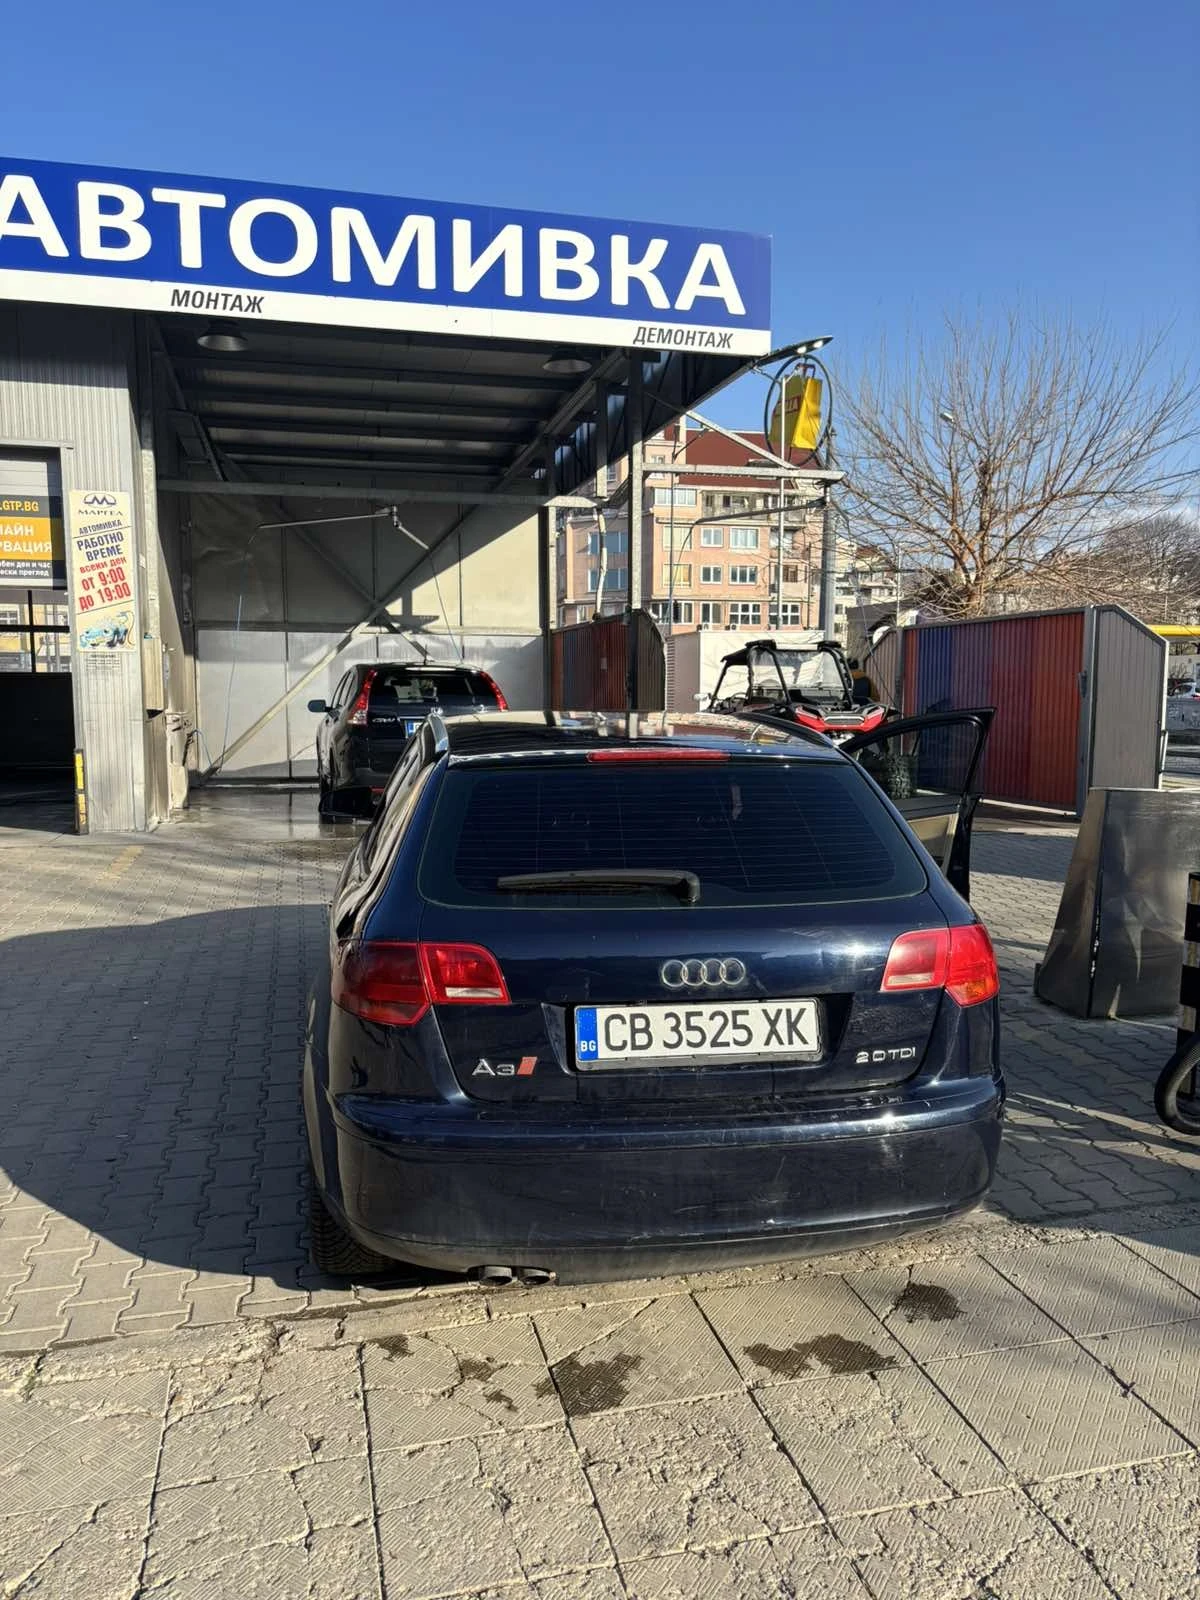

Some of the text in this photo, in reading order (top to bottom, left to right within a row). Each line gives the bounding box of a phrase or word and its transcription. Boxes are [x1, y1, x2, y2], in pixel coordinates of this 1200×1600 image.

[0, 174, 746, 315] АВТОМИВКА
[171, 288, 264, 313] МОНТАЖ
[633, 326, 734, 349] ДЕМОНТАЖ
[78, 519, 122, 535] АВТОМИВКА
[76, 531, 124, 551] РАБОТНО
[85, 544, 123, 562] ВРЕМЕ
[98, 566, 126, 586] 9:00
[97, 582, 131, 603] 19:00
[604, 1007, 809, 1051] CB 3525 XK
[580, 1040, 597, 1052] BG
[887, 1046, 917, 1060] TDI
[471, 1058, 516, 1076] A3
